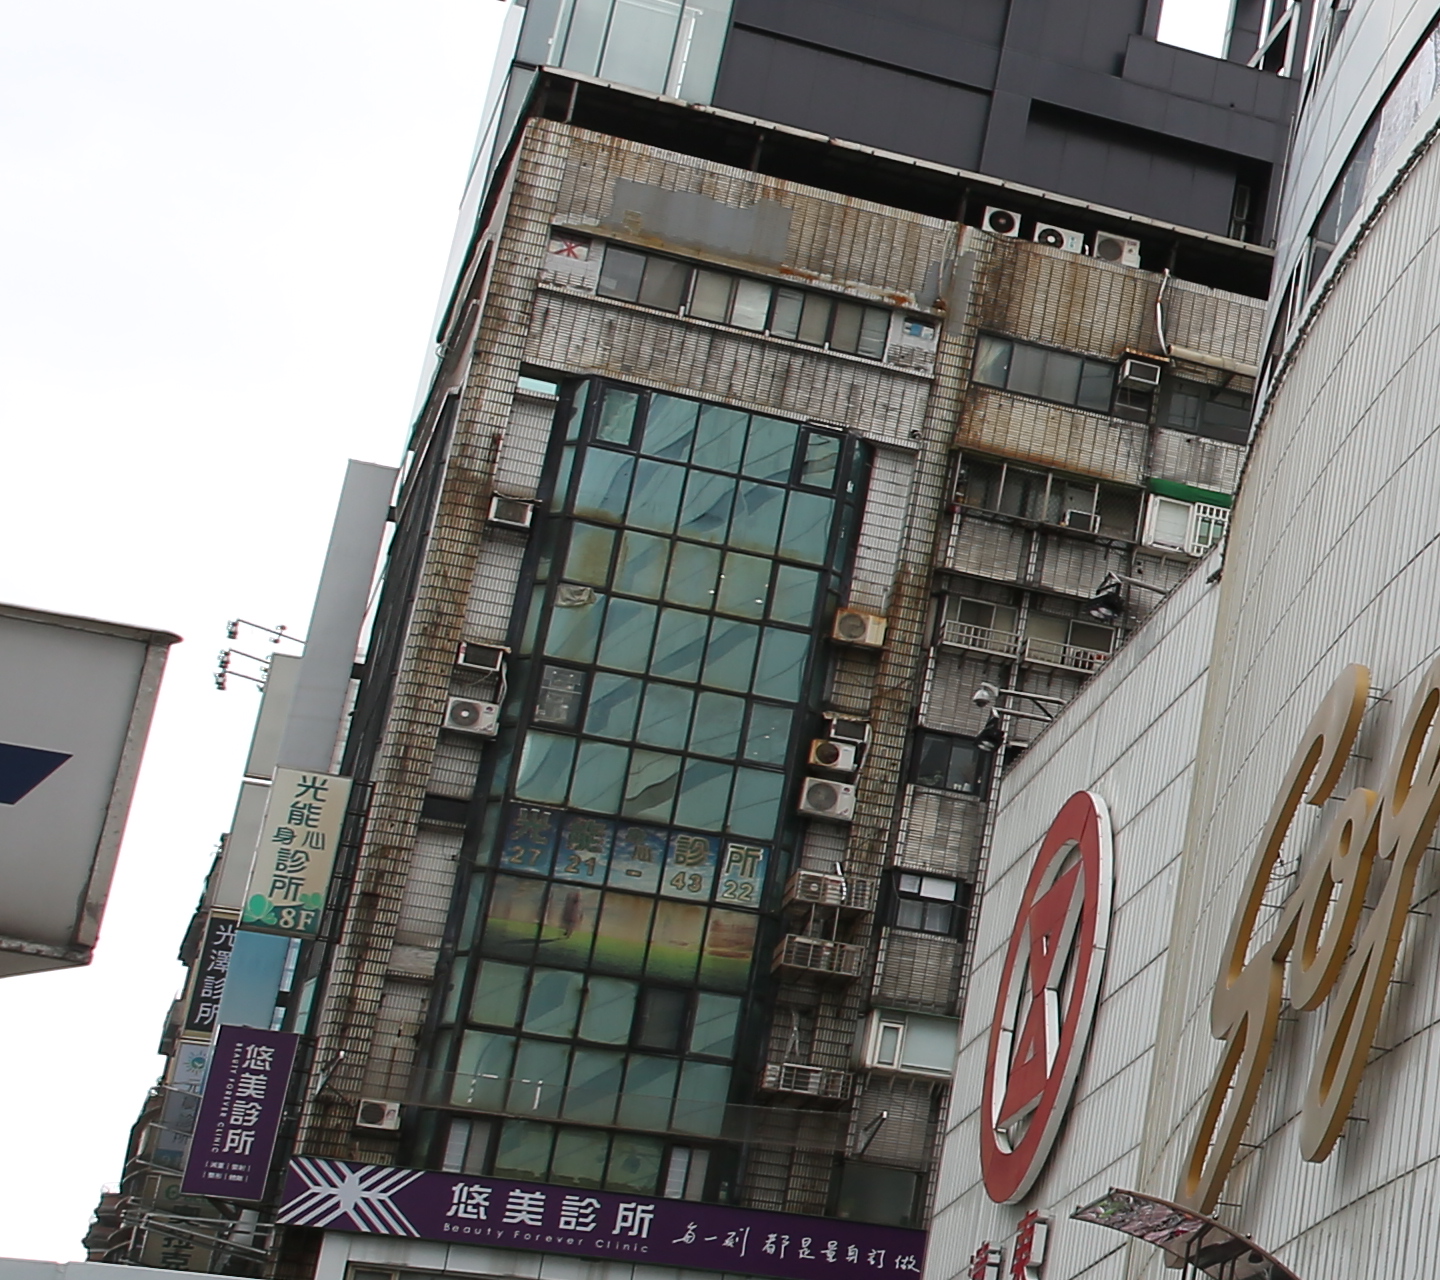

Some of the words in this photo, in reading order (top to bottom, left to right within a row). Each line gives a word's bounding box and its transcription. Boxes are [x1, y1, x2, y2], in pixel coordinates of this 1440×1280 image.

[277, 907, 316, 932] 8F
[222, 1043, 276, 1157] 悠美診所
[210, 1121, 225, 1154] CLINIC
[445, 1181, 656, 1240] 悠美診所
[443, 1222, 506, 1241] Beauty
[513, 1229, 586, 1247] Forever
[594, 1238, 650, 1255] Clinic
